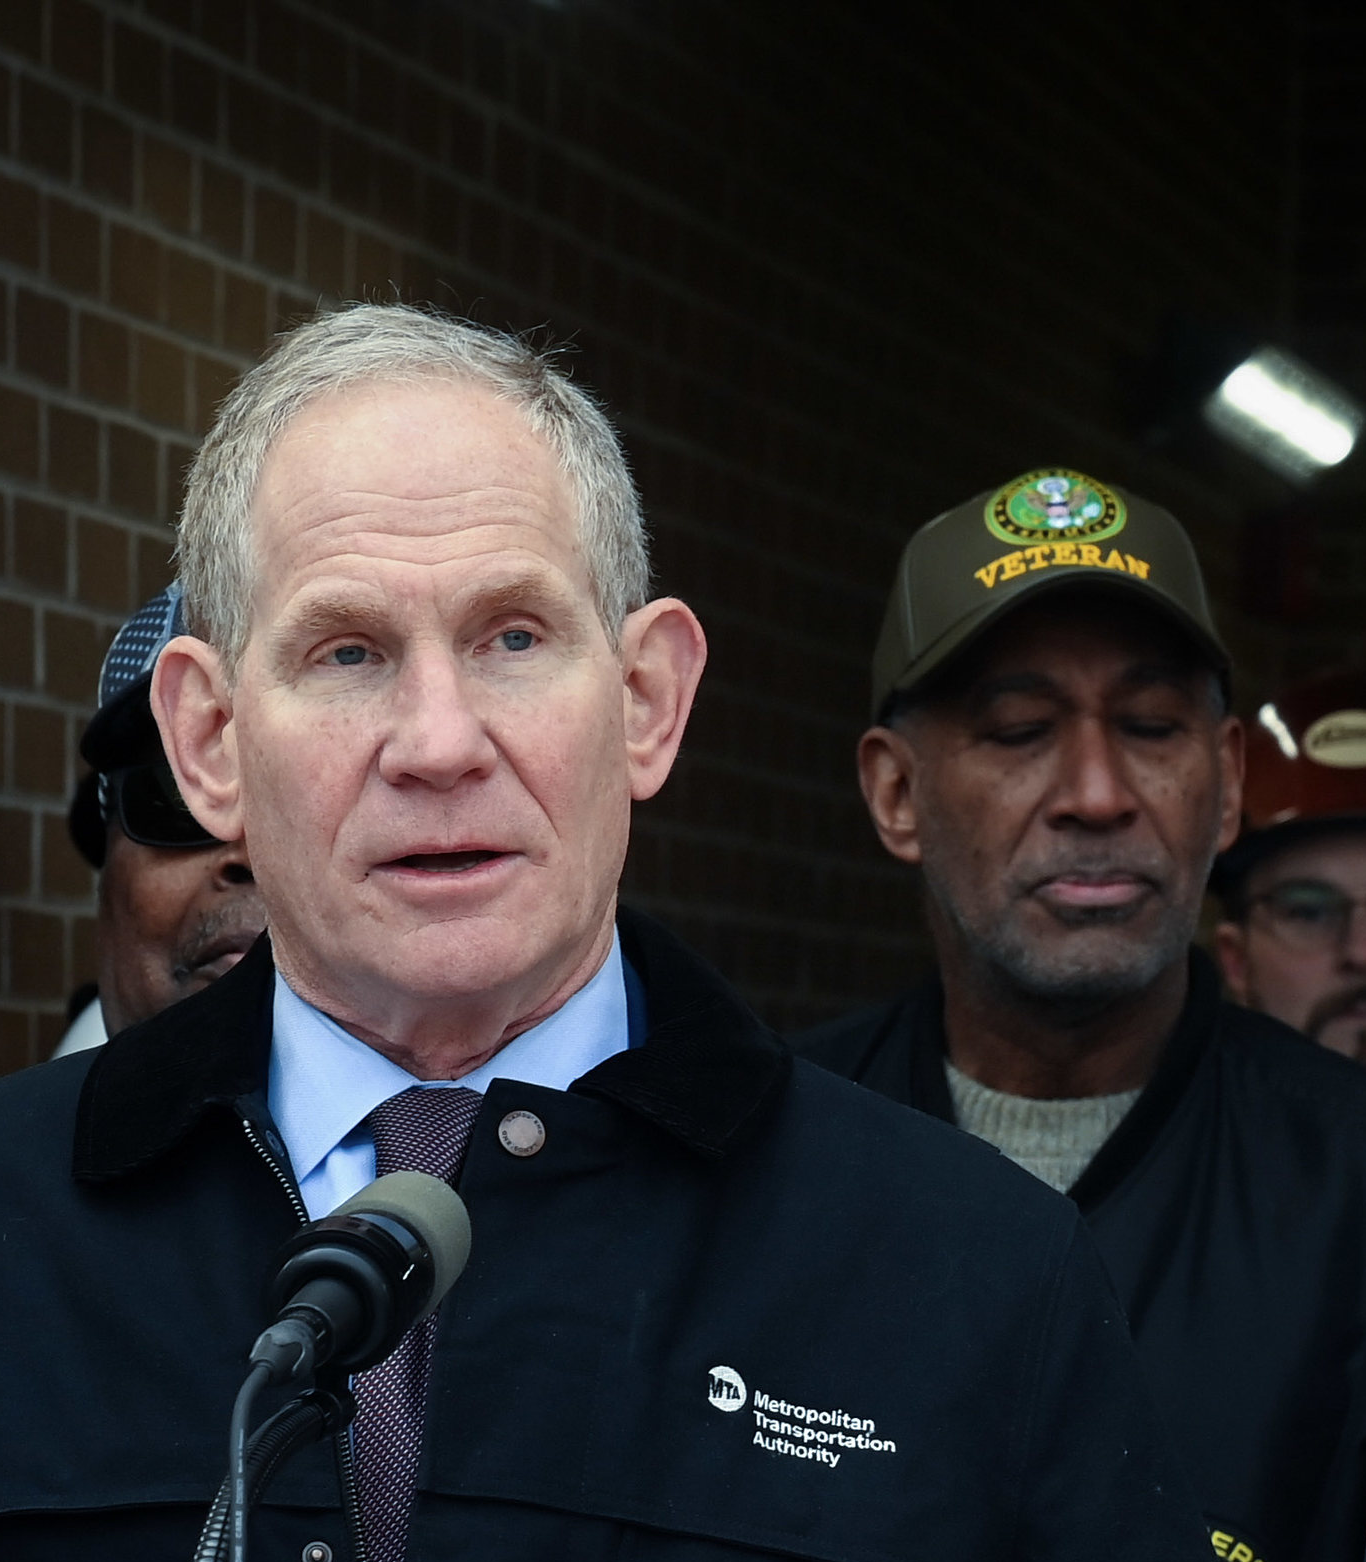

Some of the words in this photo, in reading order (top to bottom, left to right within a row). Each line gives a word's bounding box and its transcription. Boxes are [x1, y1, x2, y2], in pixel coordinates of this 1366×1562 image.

[975, 541, 1151, 588] VETERAN
[752, 1410, 897, 1453] Transportation
[753, 1389, 876, 1433] Metropolitan
[752, 1430, 841, 1469] Authority
